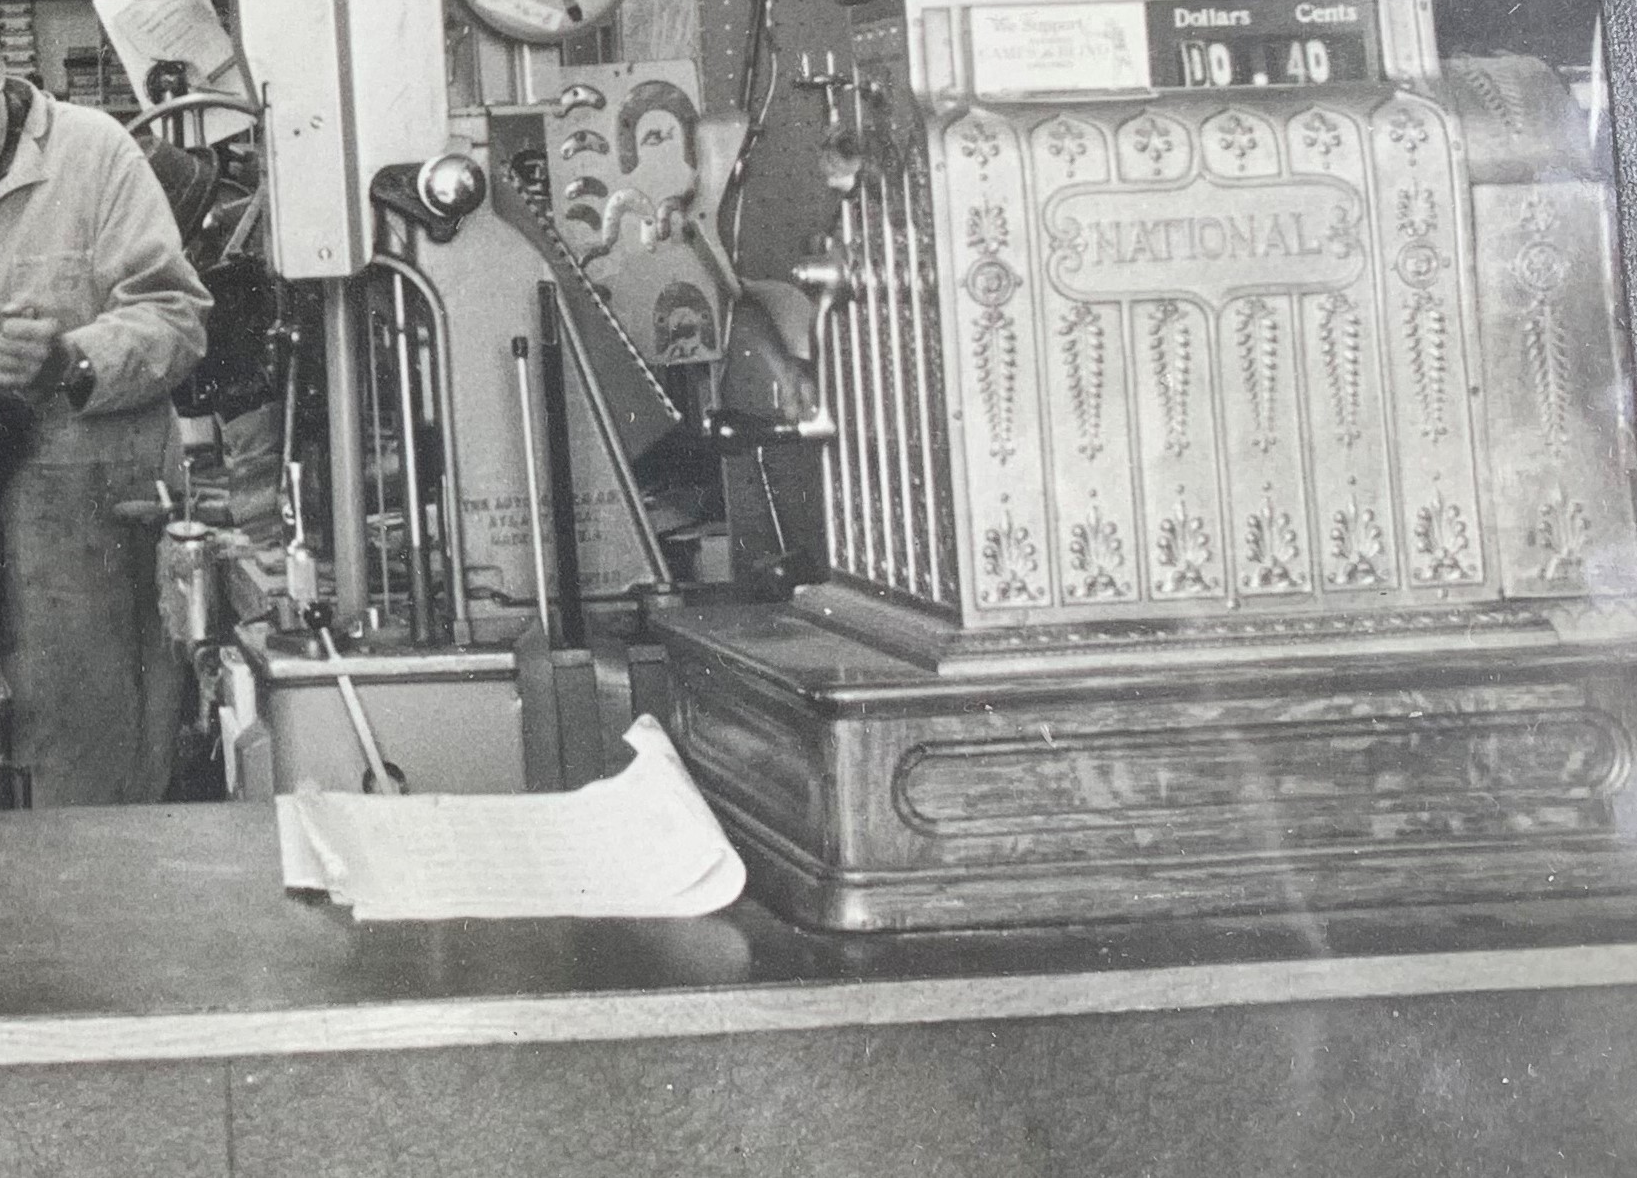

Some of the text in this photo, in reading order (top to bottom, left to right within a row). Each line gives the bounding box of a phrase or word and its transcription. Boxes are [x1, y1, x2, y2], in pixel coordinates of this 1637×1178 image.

[1173, 3, 1358, 28] Dollars Cents
[1091, 212, 1322, 265] NATIONAL
